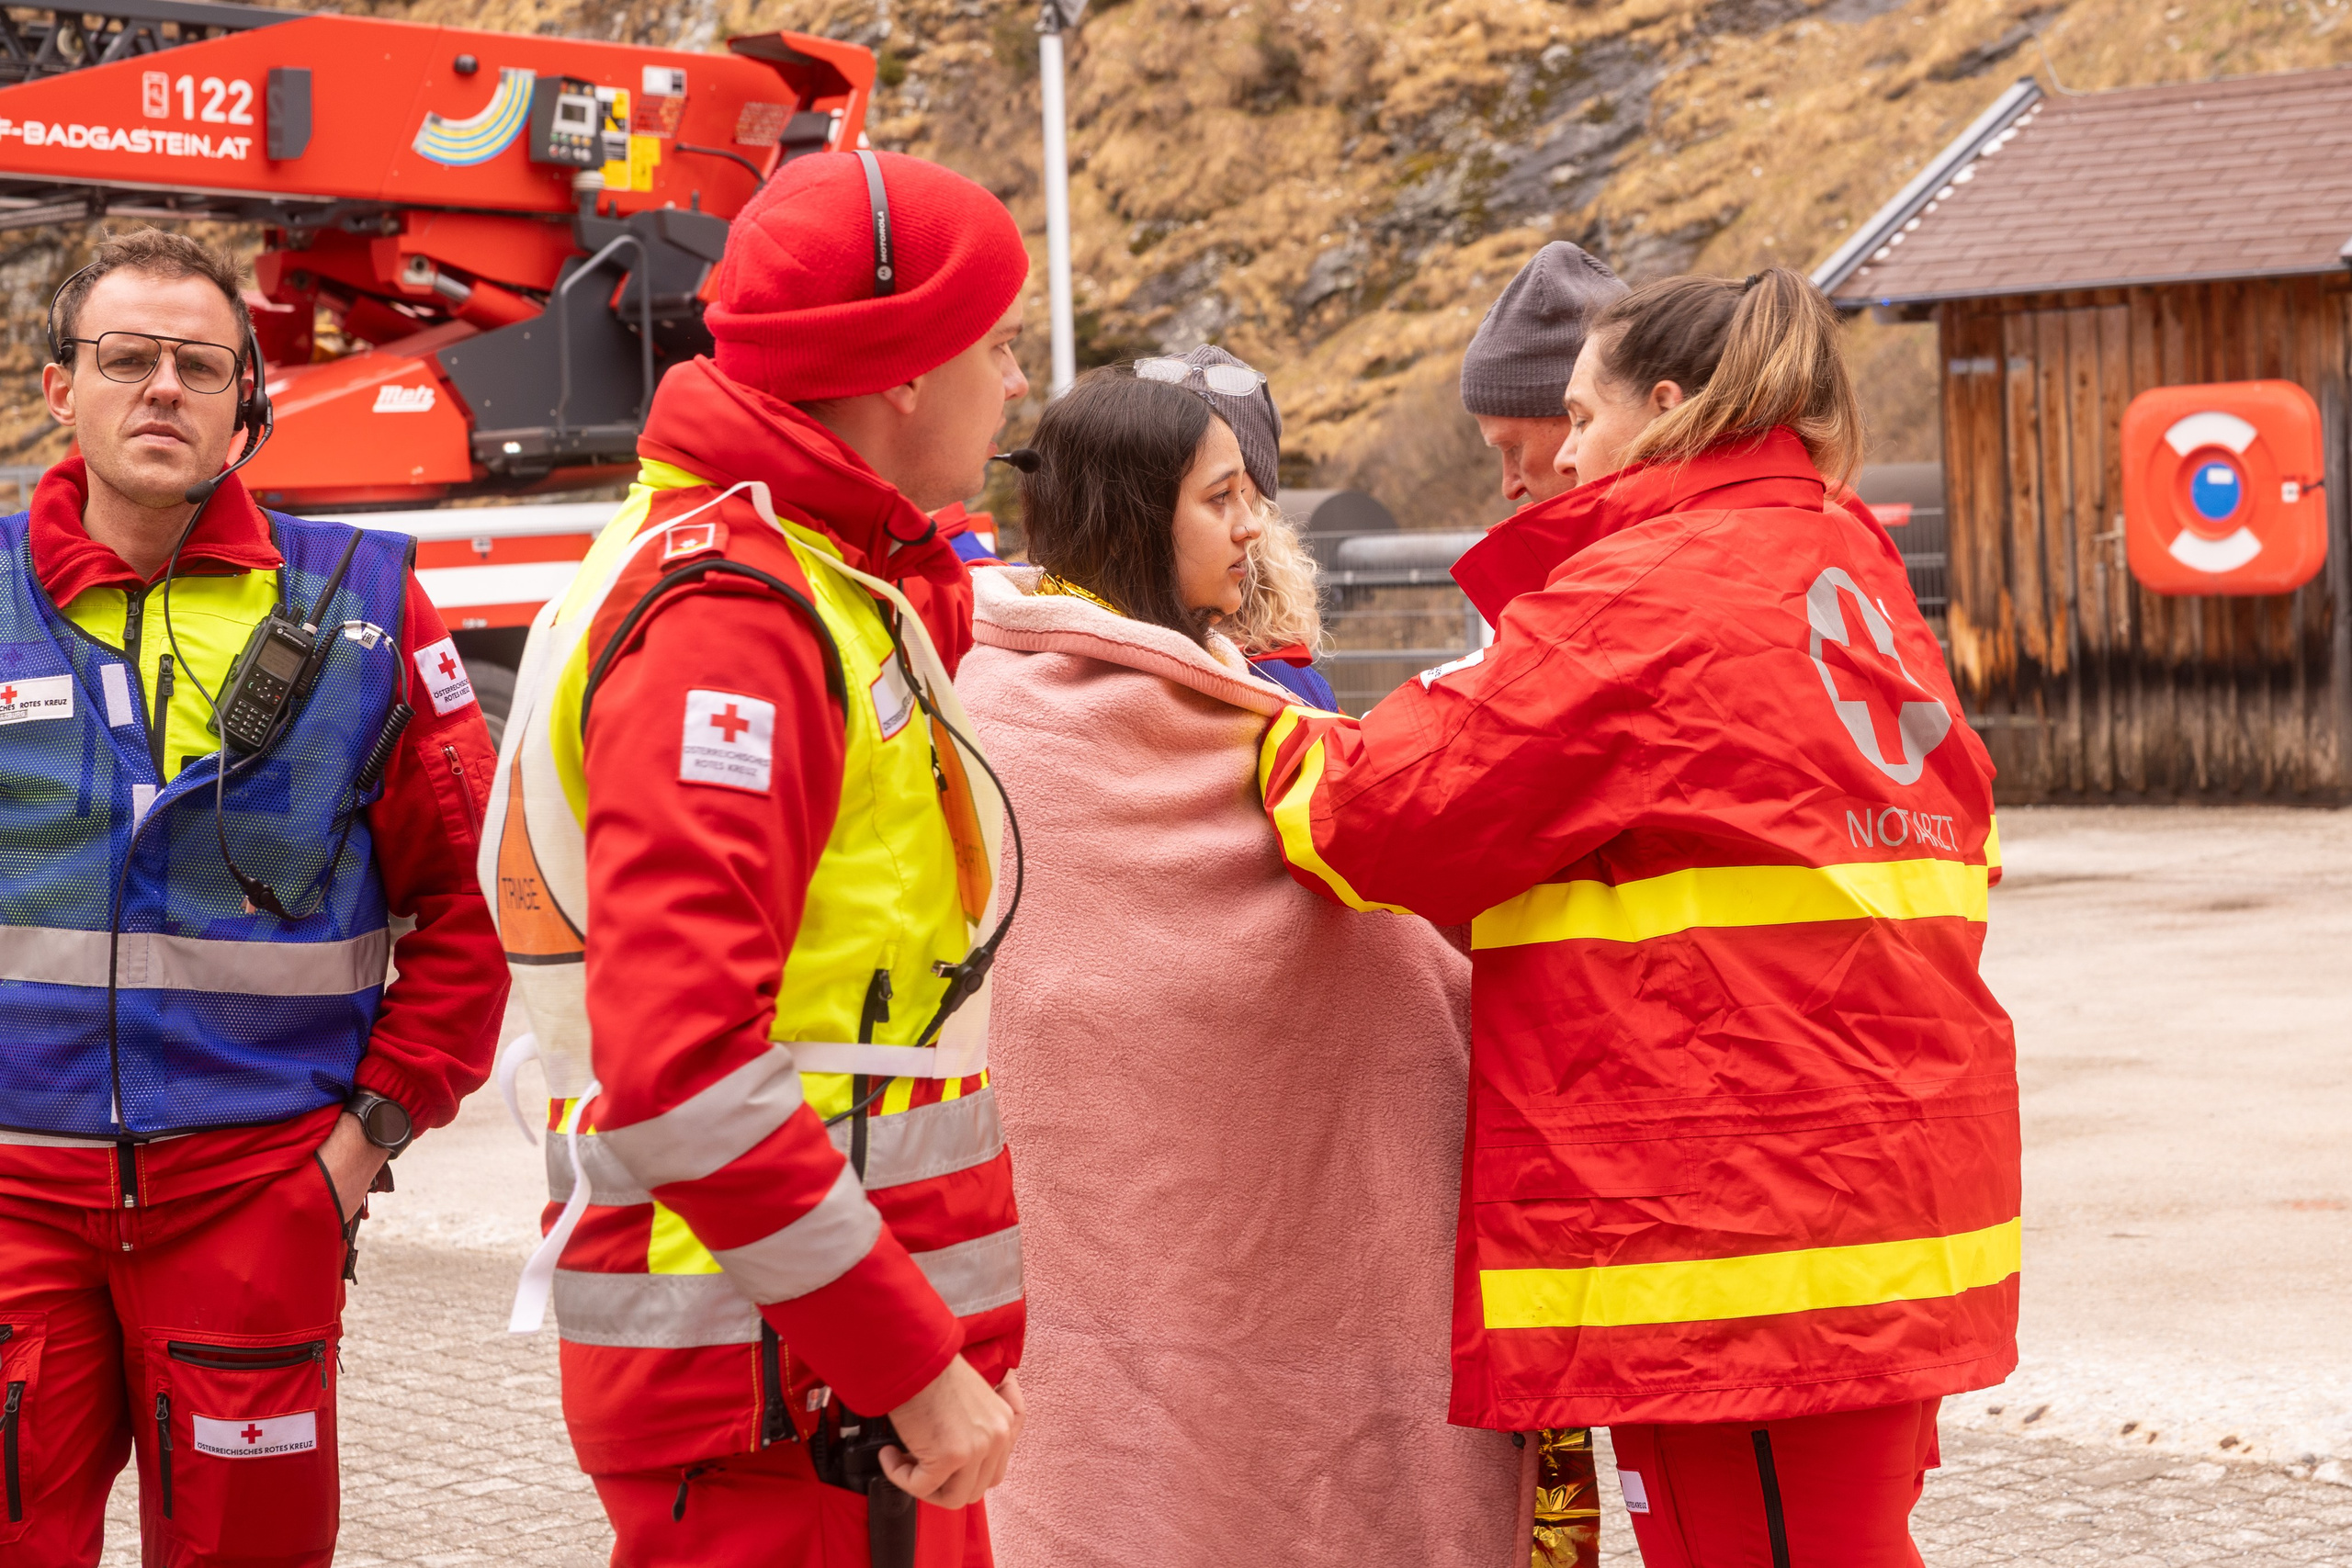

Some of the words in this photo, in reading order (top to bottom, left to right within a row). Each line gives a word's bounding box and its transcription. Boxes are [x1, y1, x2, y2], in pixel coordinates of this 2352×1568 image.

[175, 74, 254, 126] 122
[876, 210, 888, 264] MOTOROLA
[372, 384, 435, 412] Metz
[283, 632, 307, 648] MOTOROLA
[19, 700, 41, 709] ROTES
[44, 698, 68, 706] KREUZ
[501, 877, 541, 910] TRIAGE
[197, 1441, 263, 1456] ÖSTERREICHISCHES
[265, 1444, 288, 1454] ROTES
[289, 1440, 313, 1450] KREUZ
